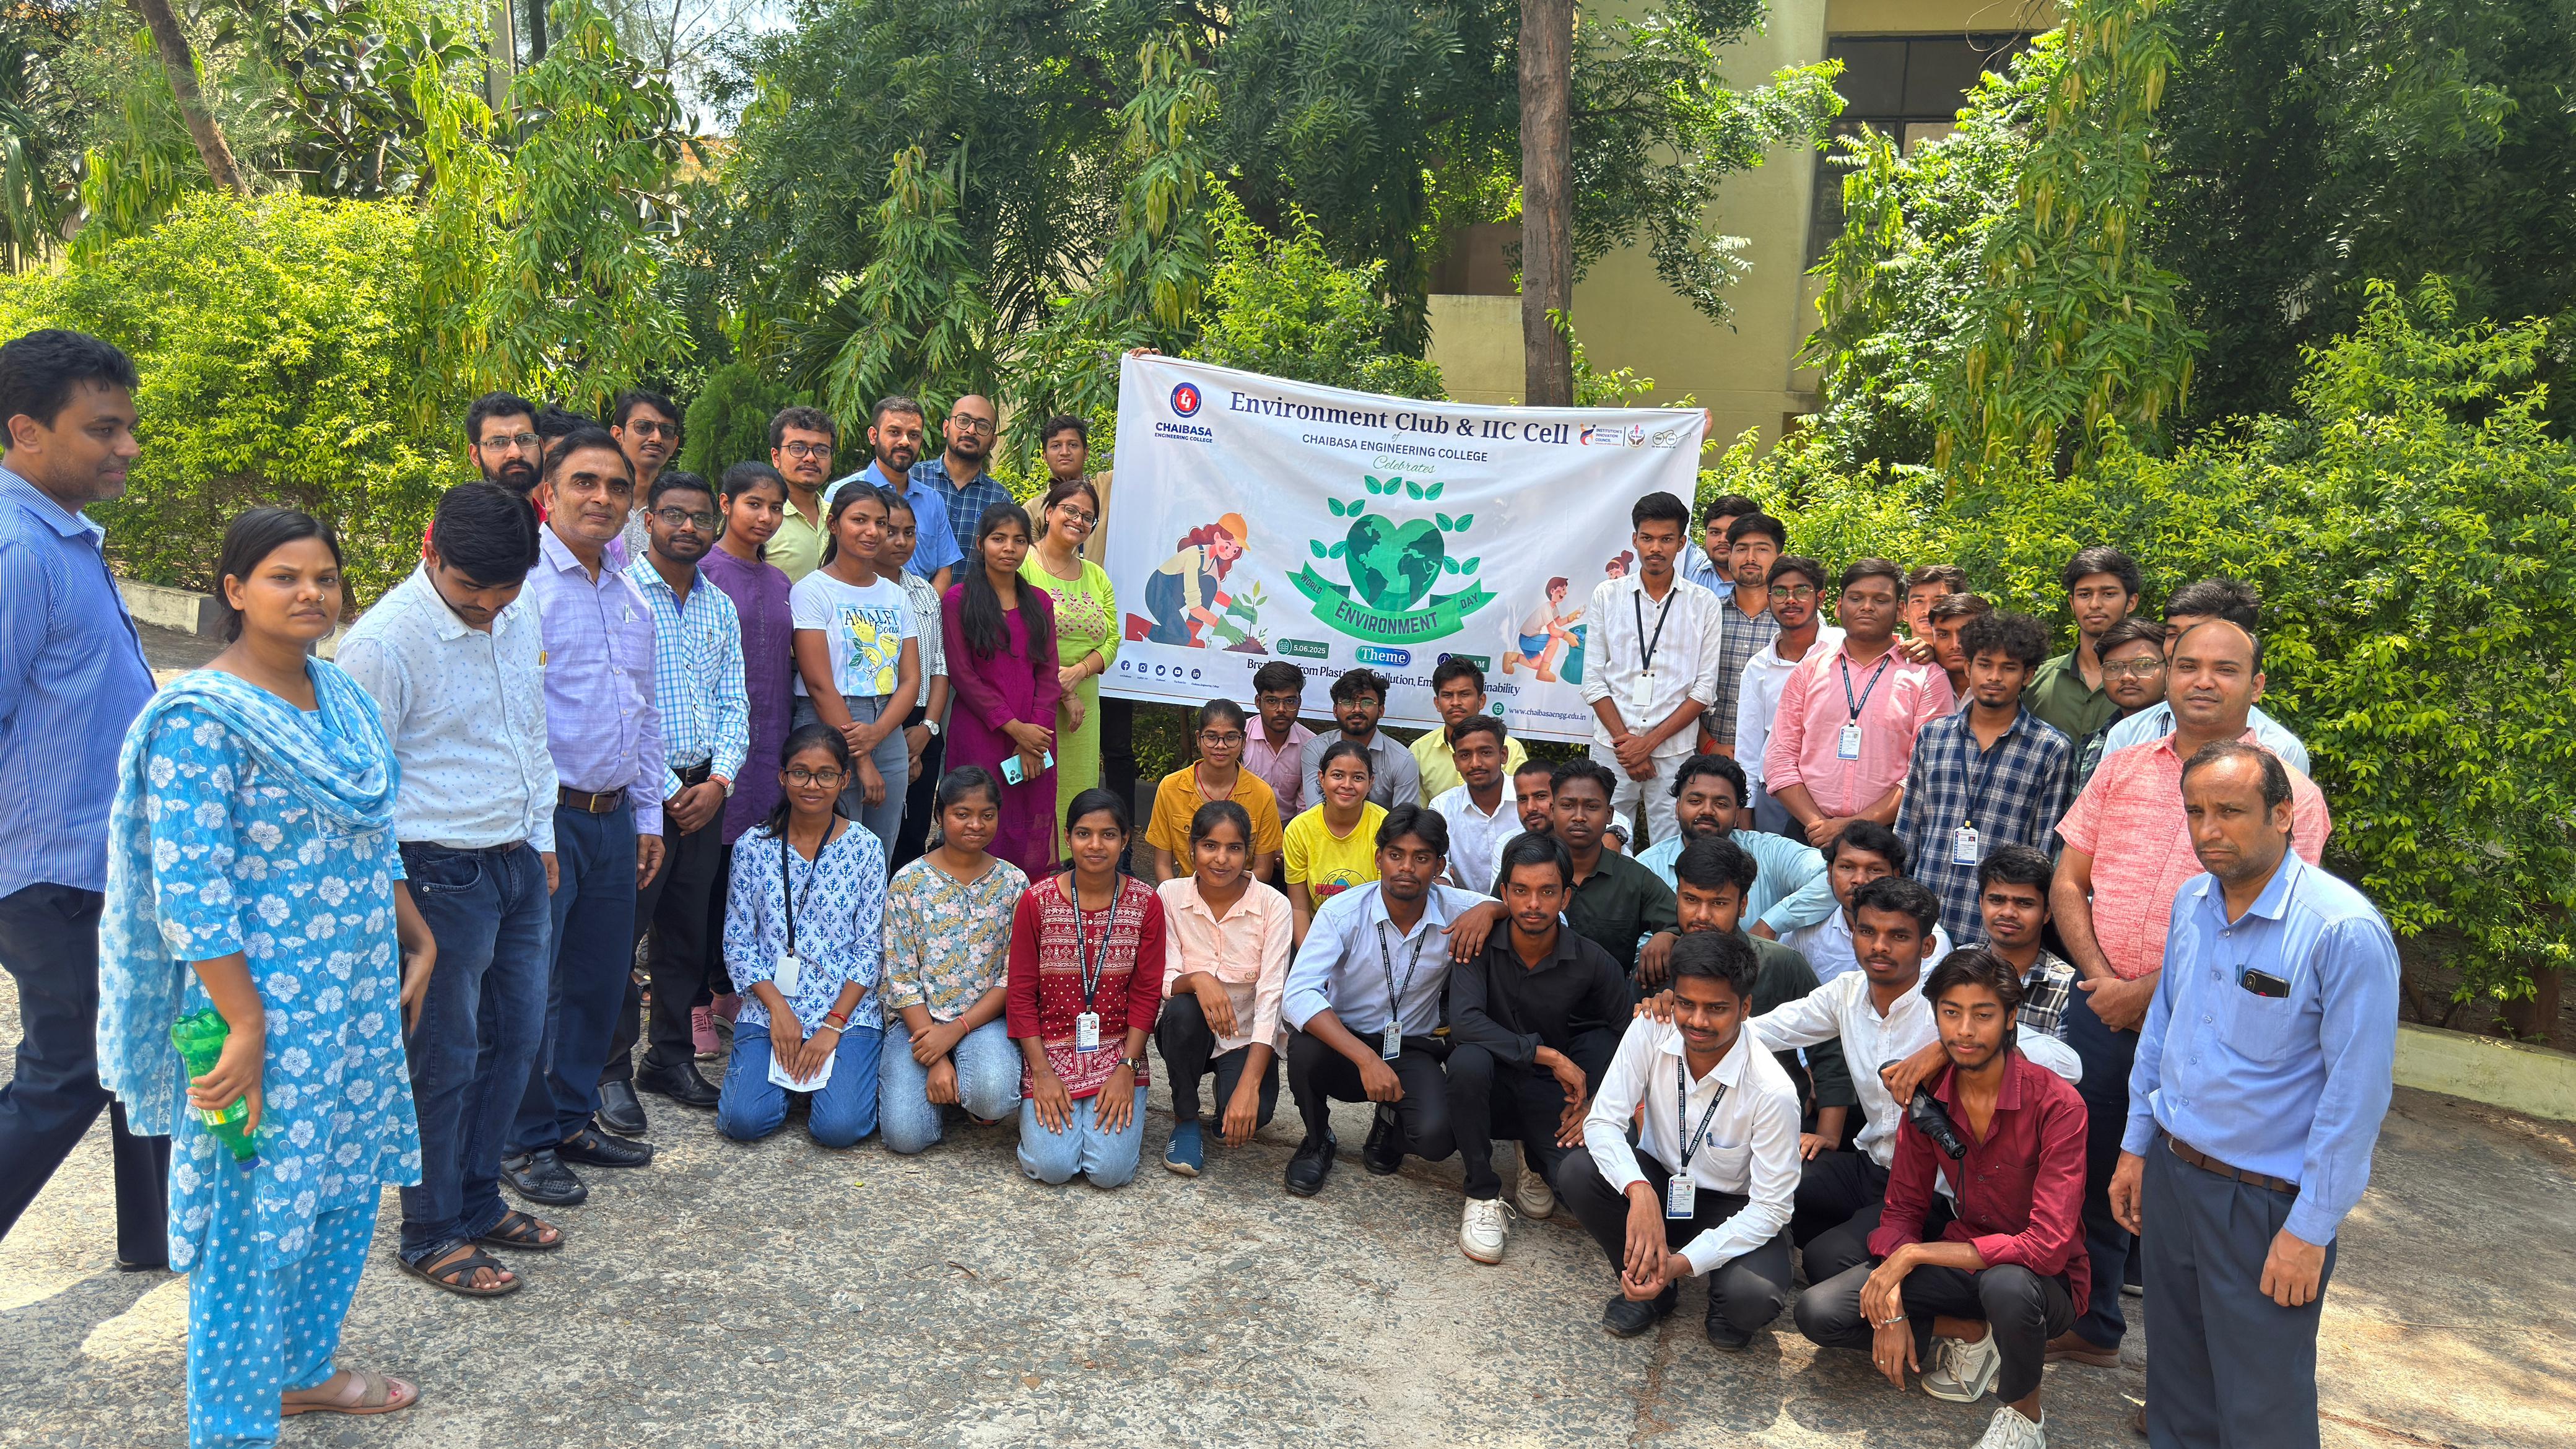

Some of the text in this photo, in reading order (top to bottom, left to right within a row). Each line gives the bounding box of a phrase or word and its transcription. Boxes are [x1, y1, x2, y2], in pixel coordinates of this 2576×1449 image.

[1229, 391, 1569, 445] Environment Club & IIC Cell
[1154, 432, 1189, 440] ENGINEERING
[1155, 422, 1212, 437] CHAIBASA
[1392, 432, 1402, 442] of
[1302, 434, 1488, 462] CHAIBASA ENGINEERING COLLEGE
[1373, 455, 1437, 474] Celebrates
[1300, 572, 1323, 595] WORLD
[1460, 593, 1479, 609] DAY
[845, 608, 899, 627] AMALFI
[1334, 600, 1437, 635] ENVIRONMENT
[1293, 645, 1326, 654] 5.06.2025
[1362, 647, 1406, 664] Theme
[1320, 666, 1346, 677] Plasti
[1484, 682, 1521, 697] inability
[1508, 708, 1586, 721] www.chaibasaengg.edu.in
[1715, 1085, 1726, 1102] CHAIBASA
[1687, 1105, 1715, 1156] CHAIBASA ENGINEERING COLLEGE
